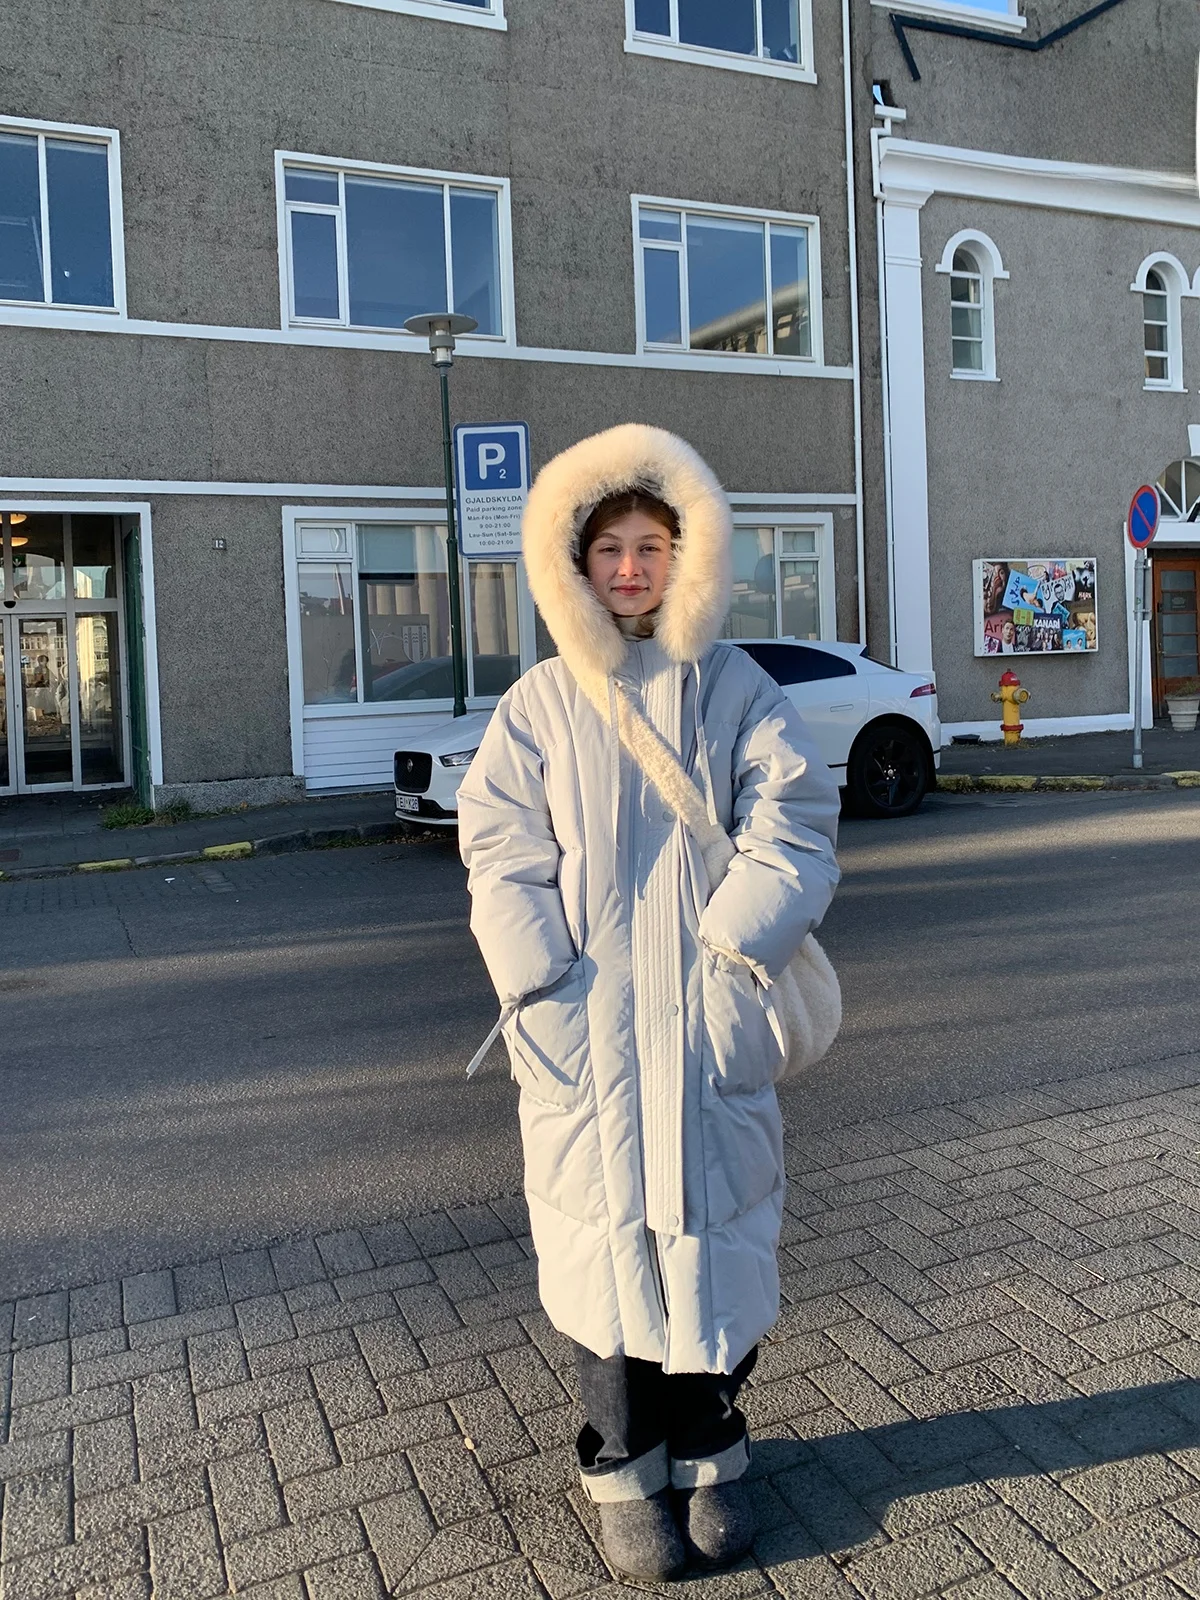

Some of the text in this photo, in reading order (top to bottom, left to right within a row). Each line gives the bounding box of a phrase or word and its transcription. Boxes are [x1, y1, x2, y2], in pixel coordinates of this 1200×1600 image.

[478, 442, 506, 480] P 2
[466, 496, 522, 504] GJALDSKYLDA
